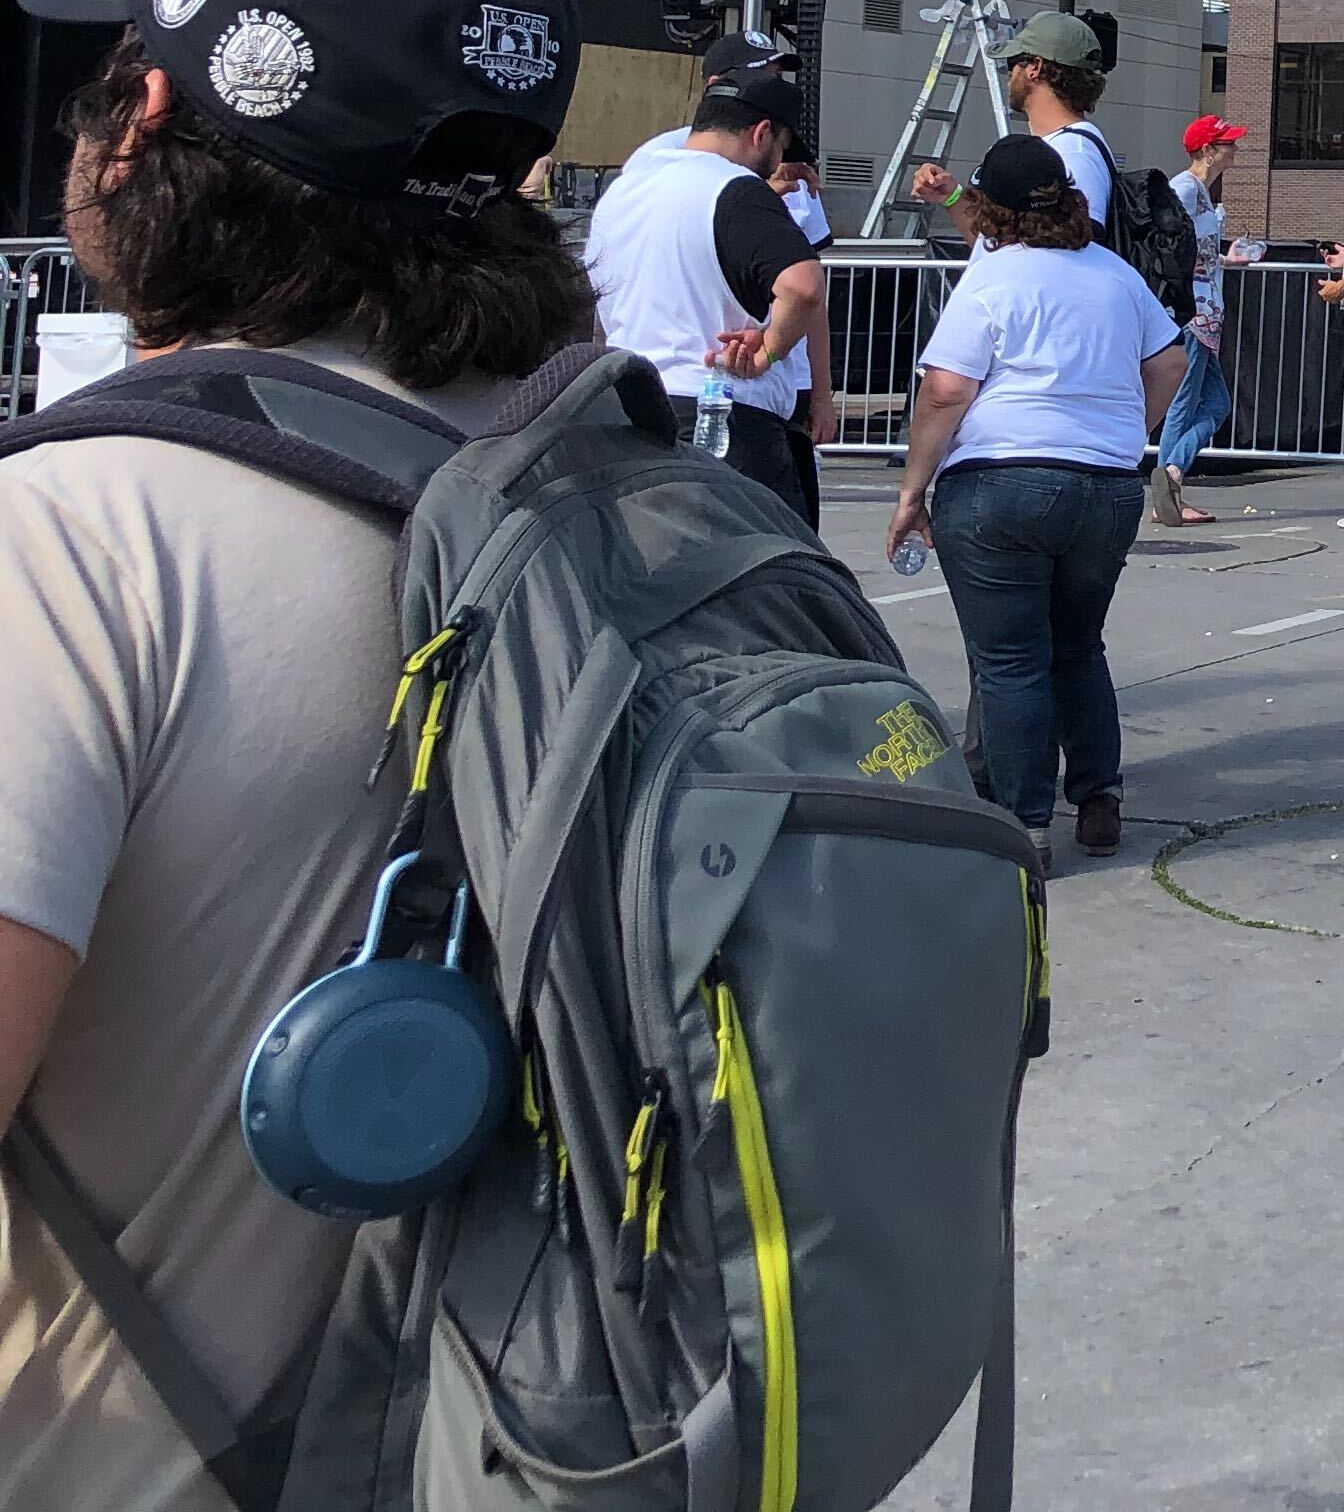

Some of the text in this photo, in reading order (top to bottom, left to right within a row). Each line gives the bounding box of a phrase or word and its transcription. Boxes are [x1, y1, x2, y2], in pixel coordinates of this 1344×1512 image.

[460, 24, 482, 39] 20
[513, 15, 546, 31] OPEN
[237, 8, 315, 73] U.S. OPEN 1982
[547, 39, 560, 54] 10
[235, 99, 283, 118] BEACH
[403, 179, 427, 194] The
[876, 700, 918, 734] THE
[857, 719, 934, 778] NORTH
